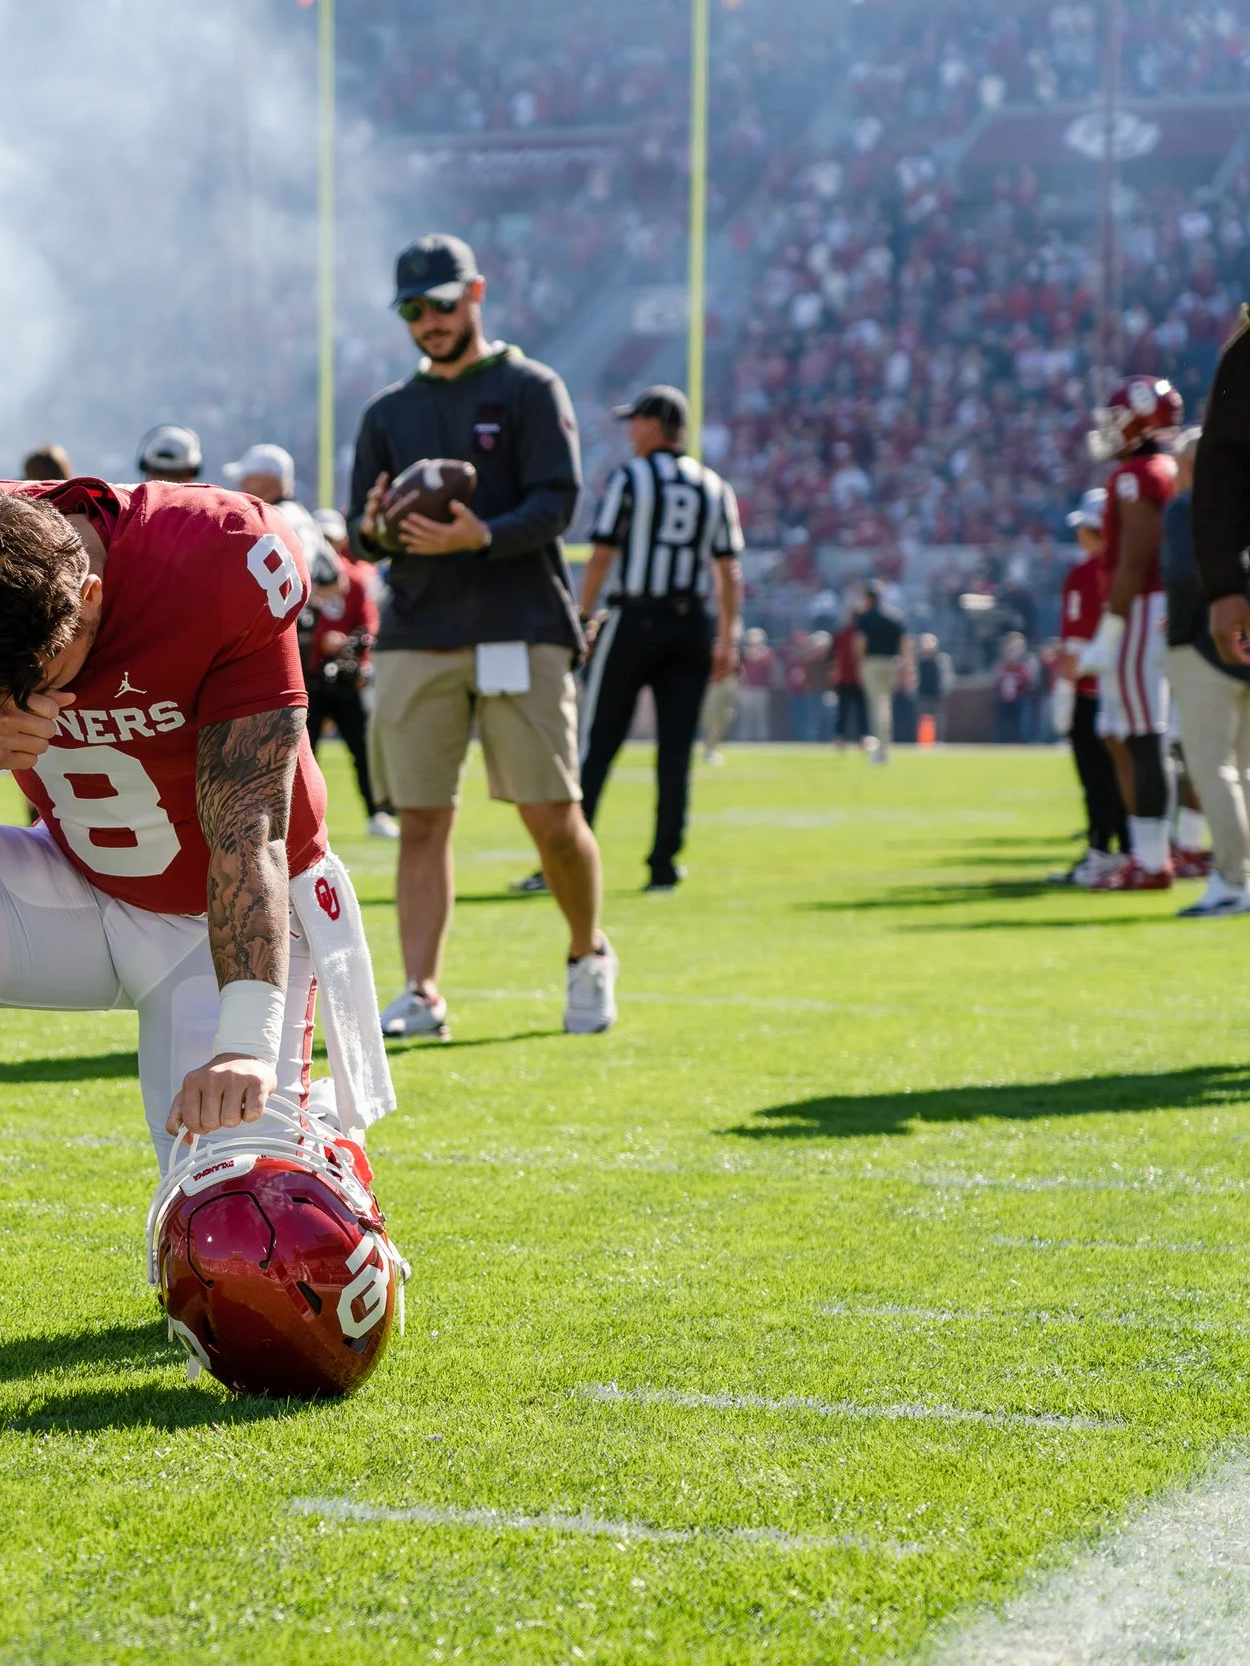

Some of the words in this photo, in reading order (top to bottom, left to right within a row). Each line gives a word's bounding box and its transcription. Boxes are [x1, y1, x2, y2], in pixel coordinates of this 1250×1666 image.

[657, 483, 701, 542] B
[246, 533, 303, 620] 8
[52, 700, 187, 745] NERS
[32, 744, 182, 878] 8
